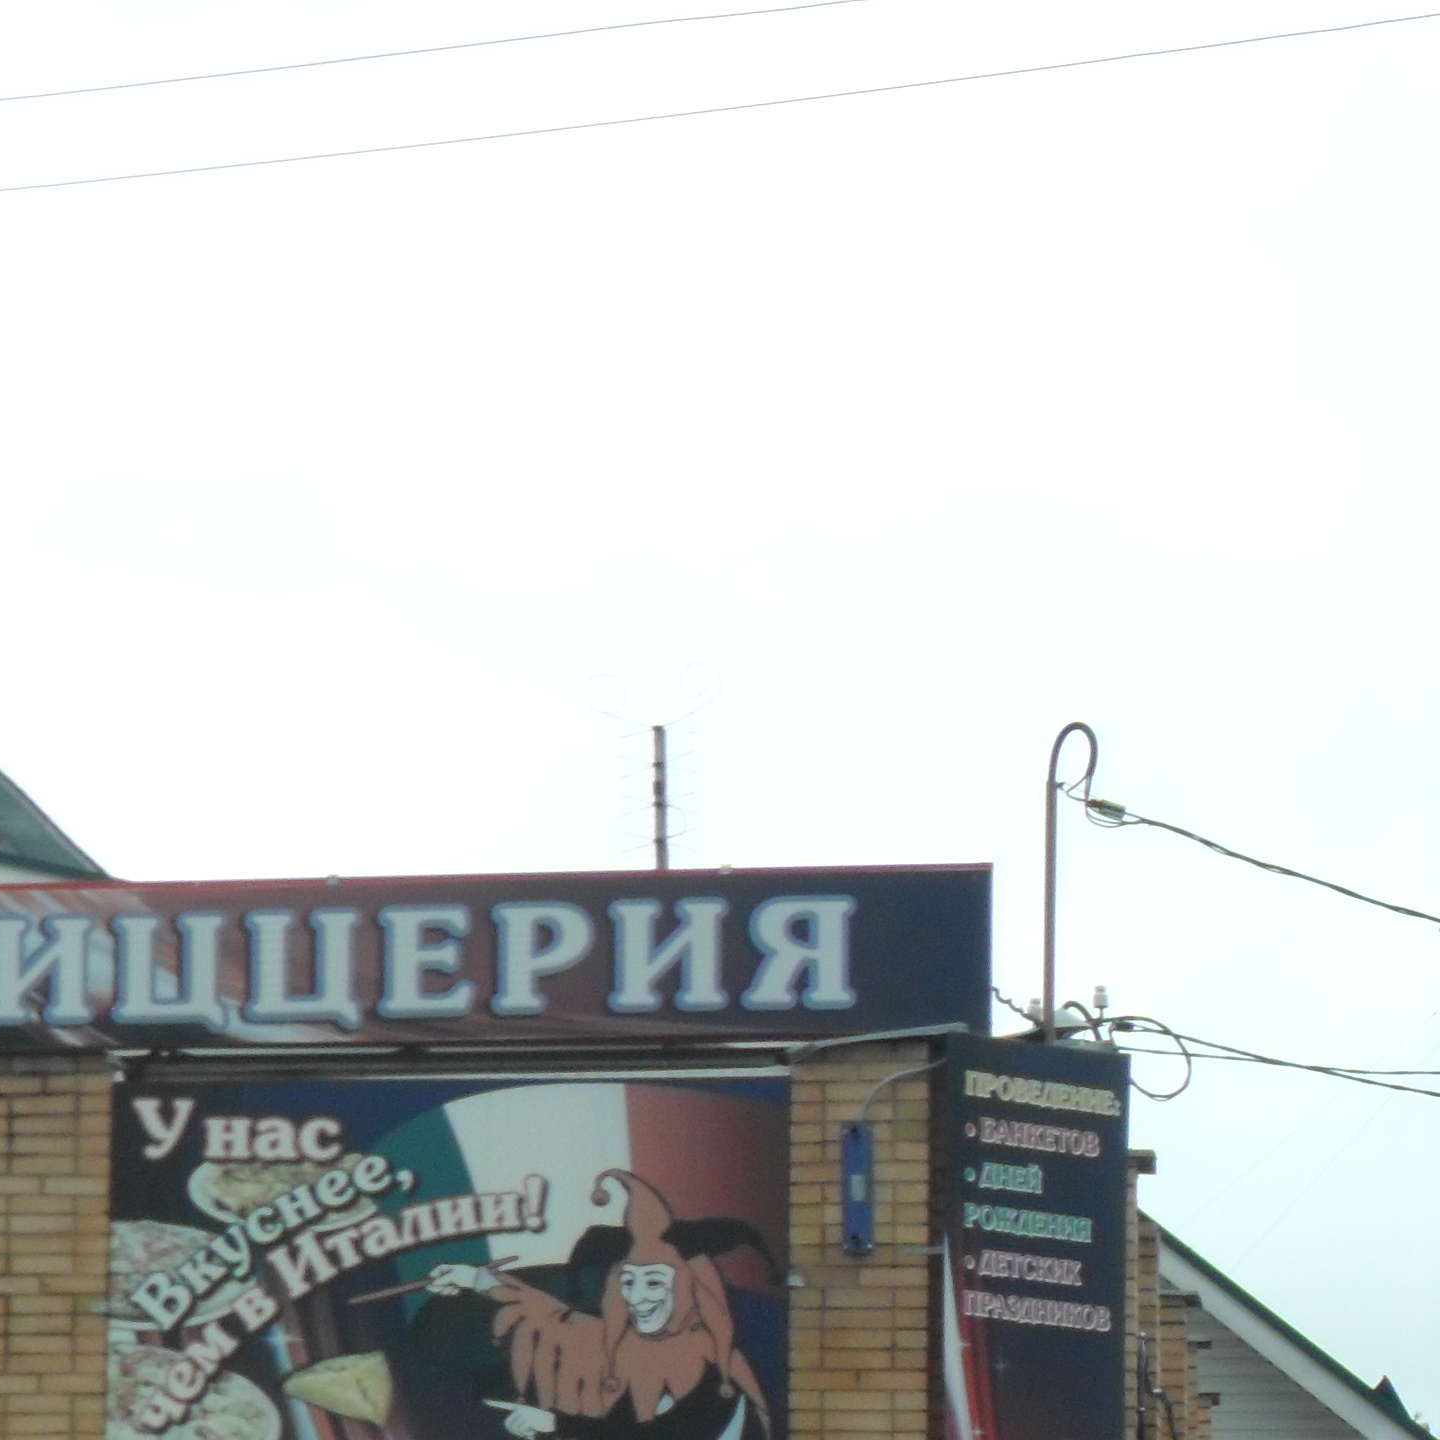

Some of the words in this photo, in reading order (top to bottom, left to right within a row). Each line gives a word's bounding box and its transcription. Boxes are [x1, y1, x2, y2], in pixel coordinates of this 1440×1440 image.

[131, 1097, 195, 1160] У
[203, 1114, 342, 1162] нас
[979, 1117, 1101, 1158] БАНКЕТОВ
[978, 1161, 1043, 1194] ДНЕЙ
[130, 1154, 415, 1330] Вкуснее,
[964, 1202, 1092, 1243] РОЖДЕНИЯ
[978, 1250, 1083, 1287] ДЕТСКИХ
[138, 1322, 240, 1430] чем
[232, 1287, 279, 1332] в
[266, 1173, 550, 1299] Италии!
[964, 1290, 1112, 1332] ПРАЗДНИКОВ
